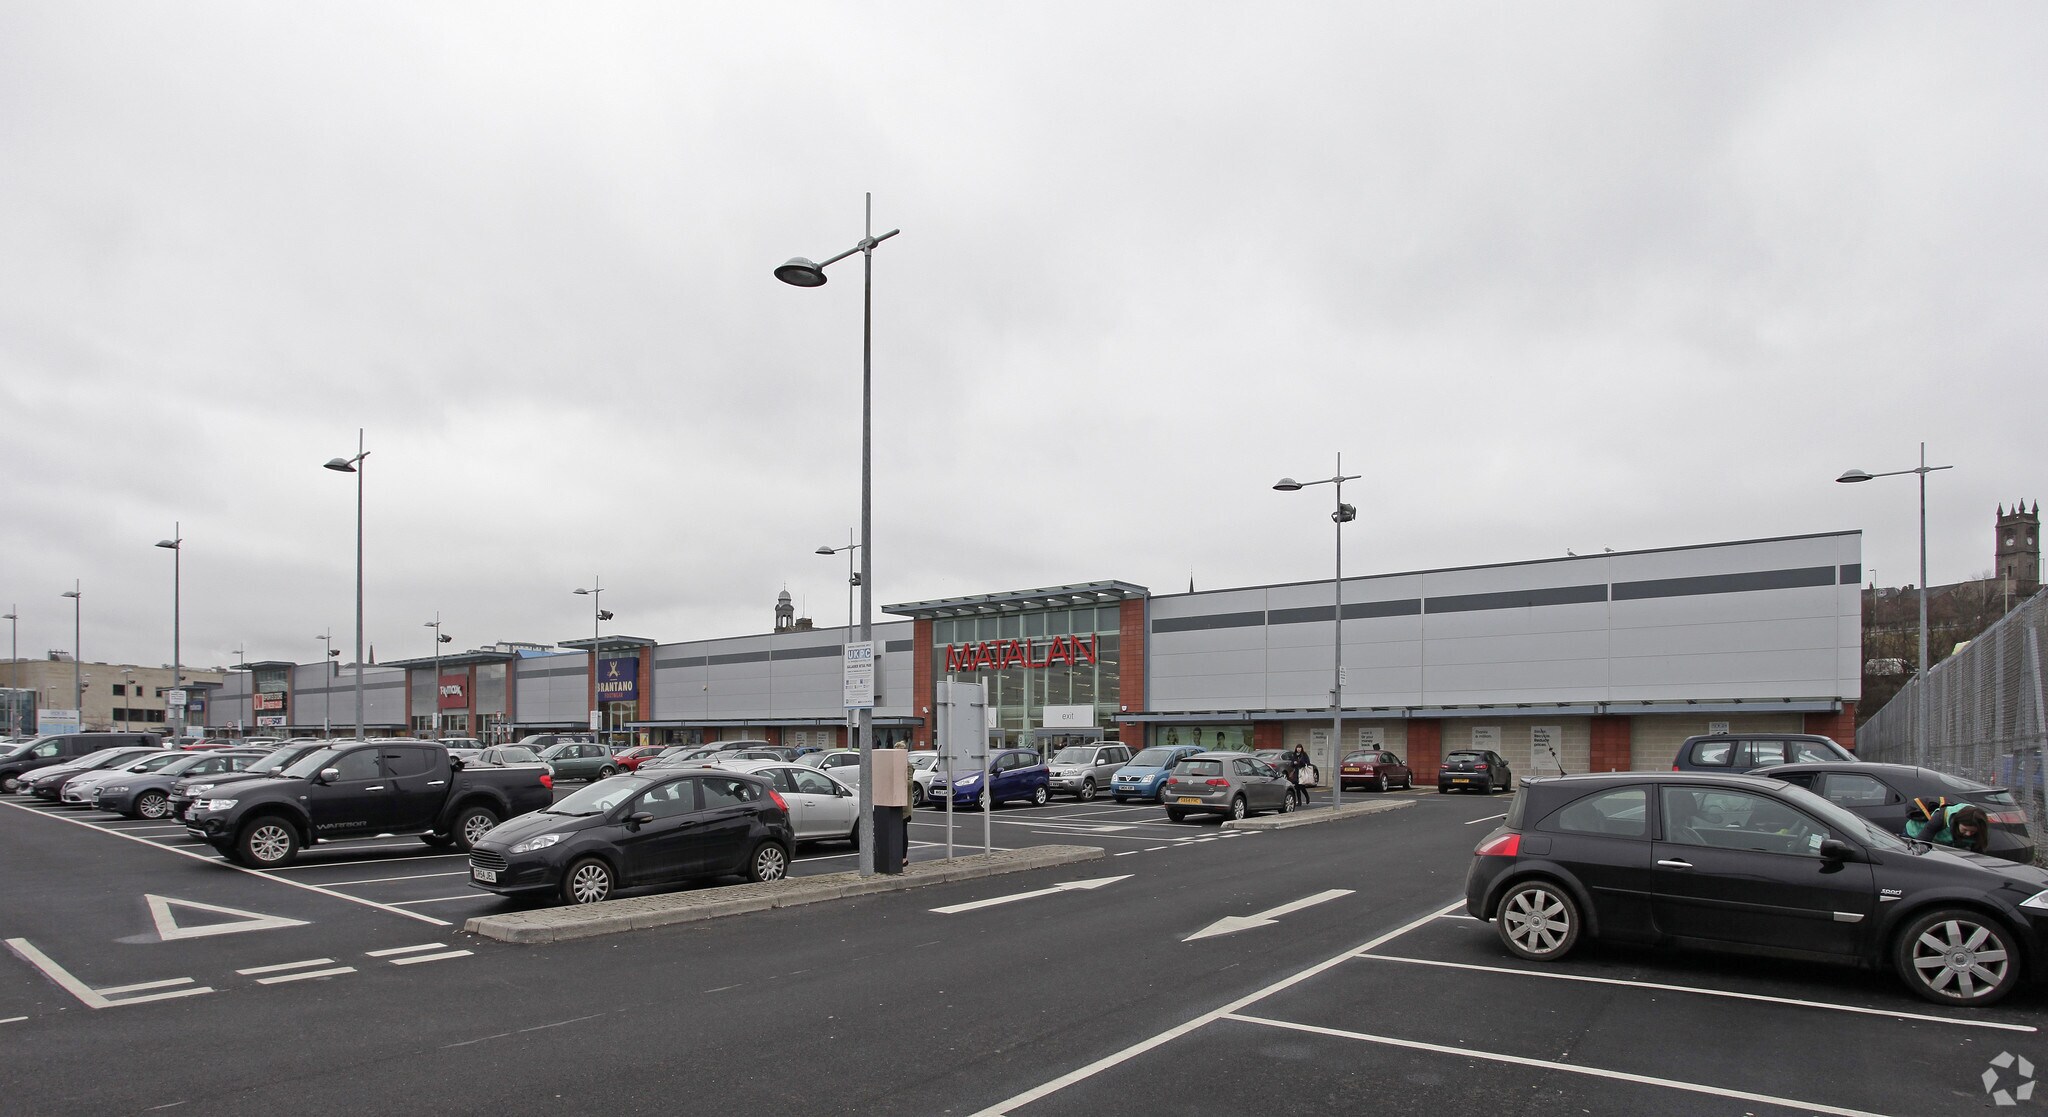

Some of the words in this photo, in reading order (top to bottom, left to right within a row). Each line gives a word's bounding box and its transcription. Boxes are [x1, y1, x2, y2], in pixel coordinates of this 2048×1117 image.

[945, 633, 1096, 672] MATALAN
[598, 680, 632, 692] BRANTANO
[1061, 712, 1074, 720] exit
[316, 820, 367, 830] WARRIOR
